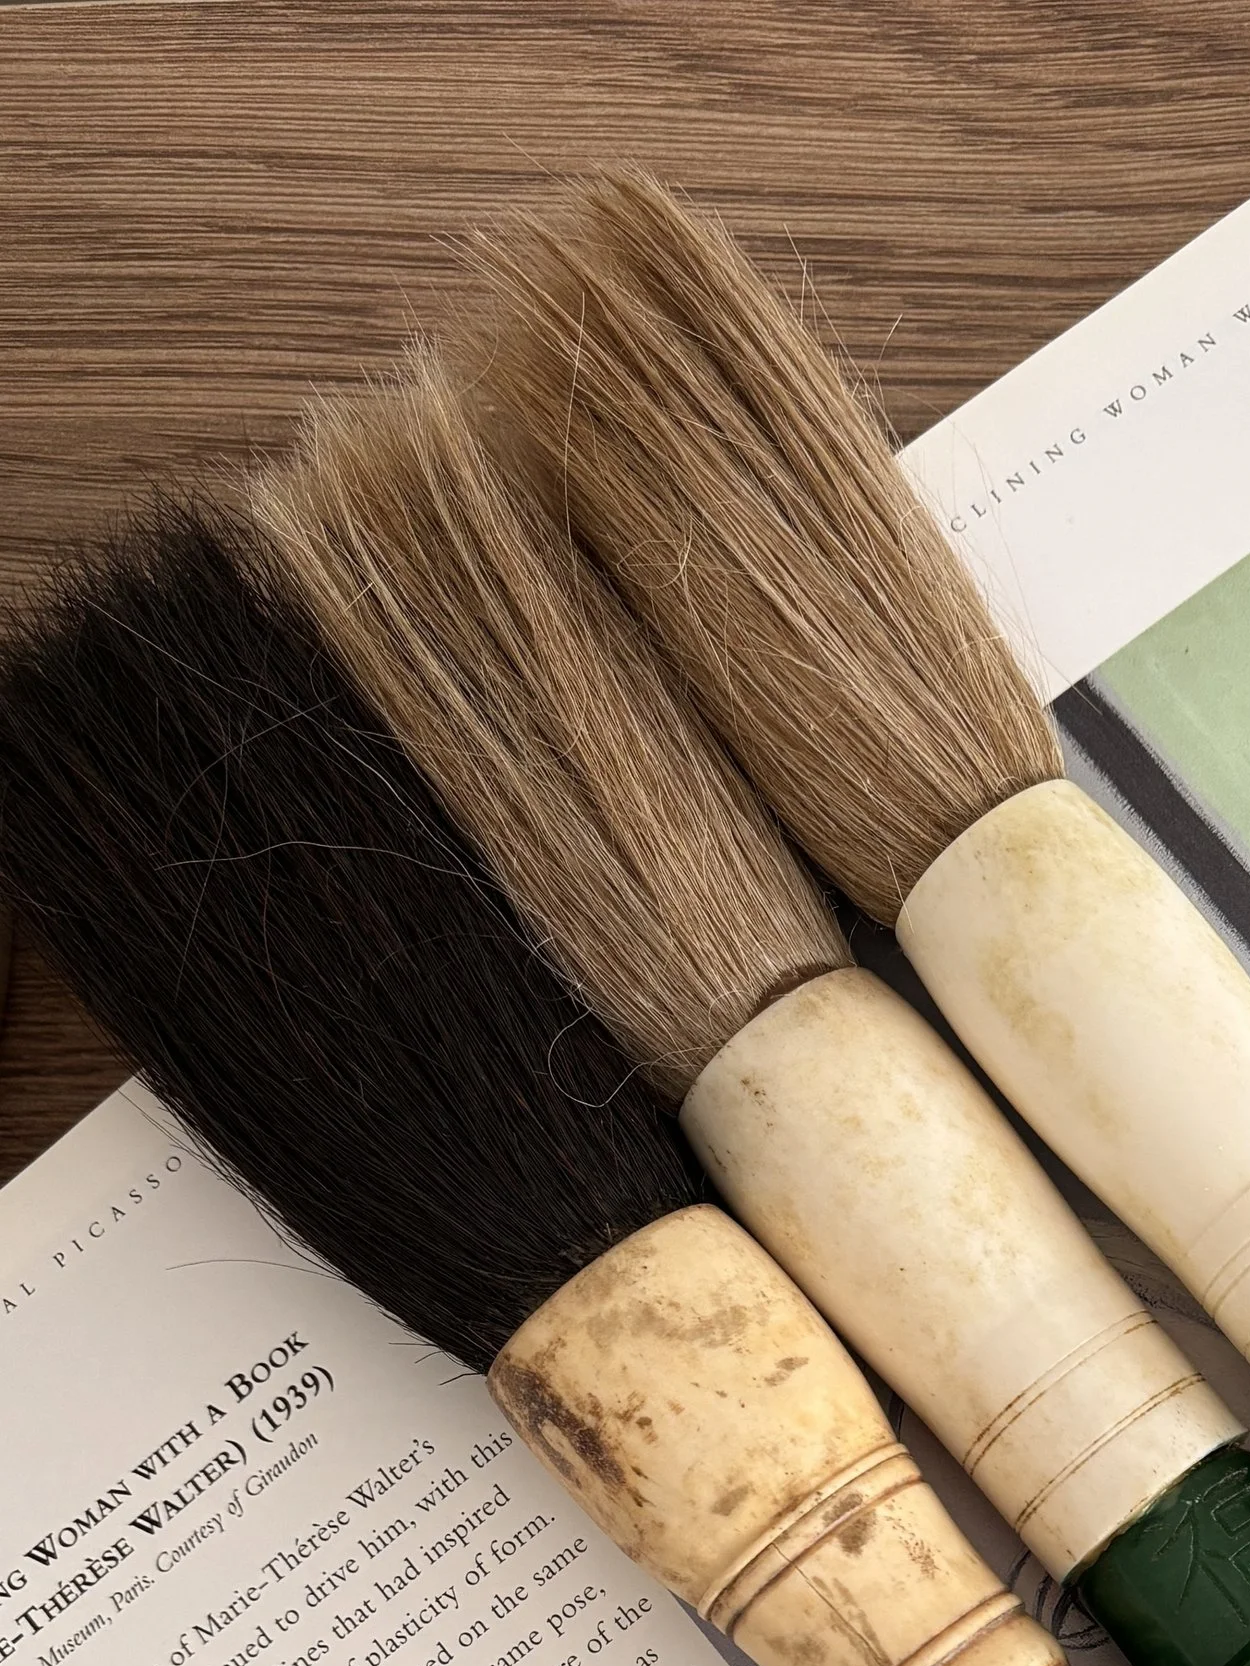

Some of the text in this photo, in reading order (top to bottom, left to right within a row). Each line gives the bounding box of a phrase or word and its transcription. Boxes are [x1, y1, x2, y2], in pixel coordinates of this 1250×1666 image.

[950, 428, 1086, 532] CLINING
[1102, 332, 1217, 418] WOMAN
[53, 1156, 182, 1268] PICASSO
[22, 1478, 133, 1567] WOMAN
[130, 1420, 204, 1481] WITH
[205, 1403, 228, 1427] A
[223, 1330, 310, 1405] BOOK
[108, 1575, 156, 1613] Paris.
[155, 1512, 225, 1573] Courtesy
[227, 1488, 244, 1518] of
[244, 1433, 319, 1497] Giraudon
[127, 1439, 248, 1536] WALTER)
[251, 1365, 335, 1444] (1939)
[331, 1599, 378, 1640] that
[373, 1556, 422, 1603] had
[419, 1482, 512, 1566] inspired
[586, 1619, 614, 1654] of
[613, 1597, 653, 1631] the
